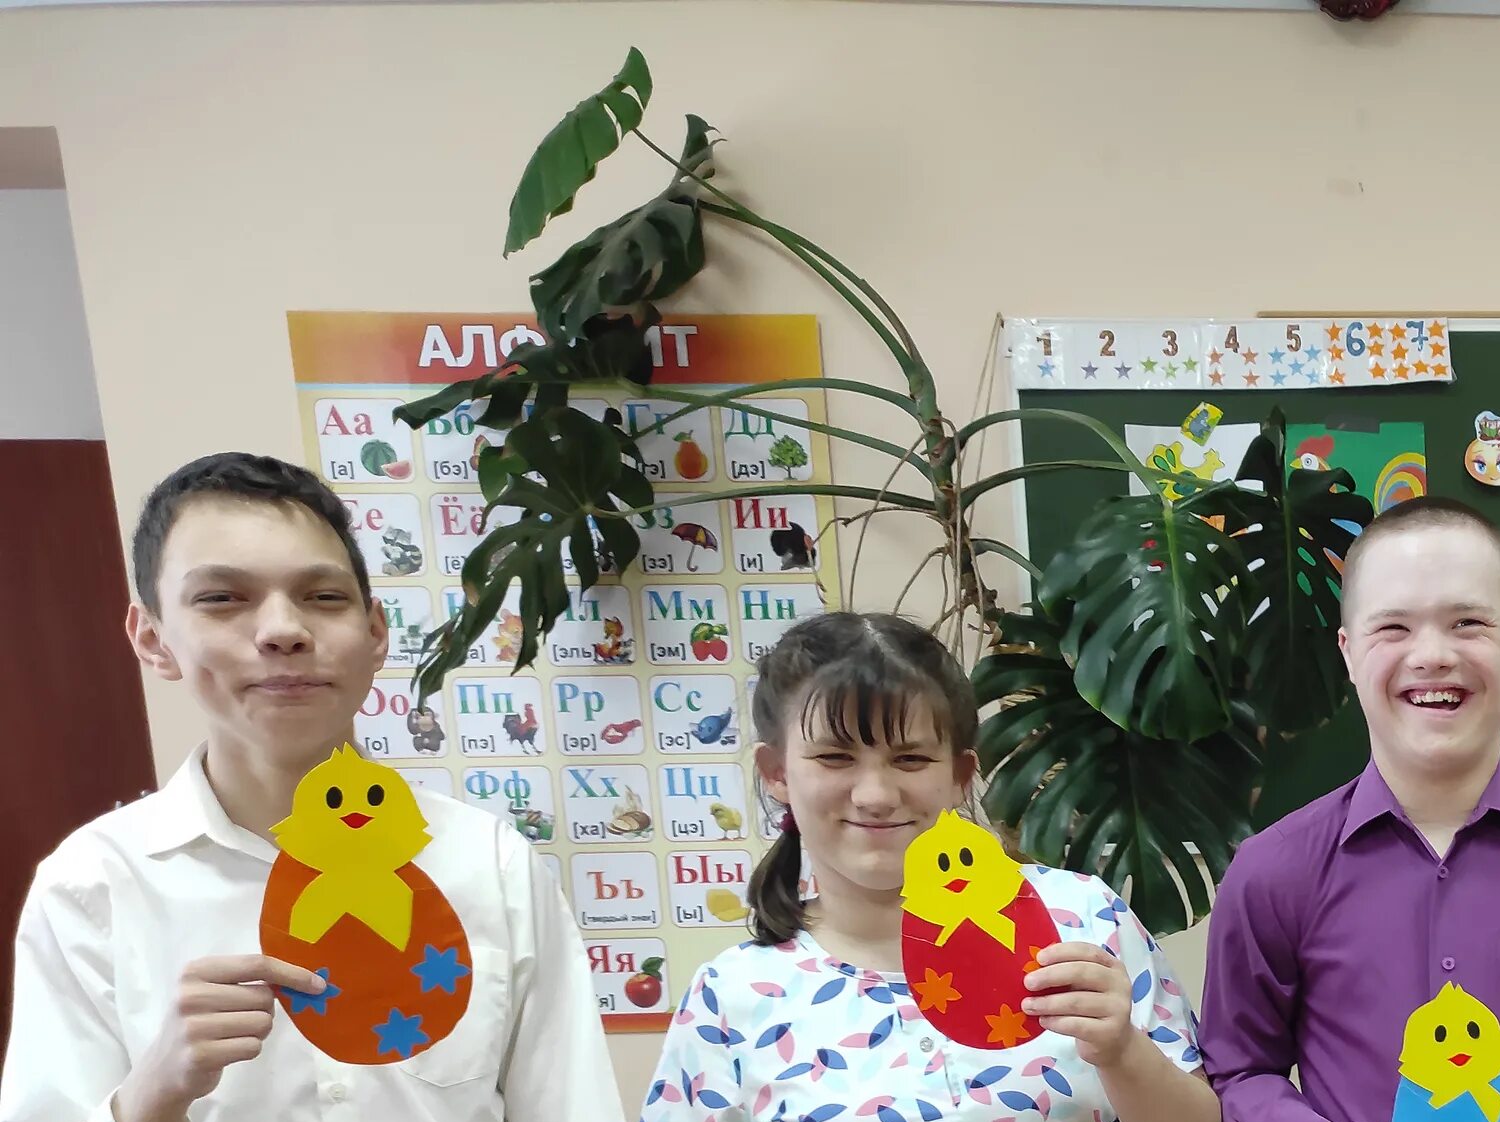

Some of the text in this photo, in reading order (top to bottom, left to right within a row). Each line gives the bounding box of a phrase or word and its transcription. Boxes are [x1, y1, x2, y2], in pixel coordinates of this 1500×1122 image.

[418, 324, 698, 367] АЛФТ
[1036, 320, 1429, 357] 1 2 3 4 5 6 7
[320, 404, 375, 436] Аа
[733, 498, 790, 530] Ии
[648, 589, 715, 622] Мм
[741, 589, 796, 621] Нн
[457, 683, 515, 715] Пп
[554, 682, 605, 722] Рр
[653, 681, 704, 713] Сс
[465, 769, 532, 809] Фф
[567, 768, 622, 799] Хх
[664, 767, 722, 803] Цц
[586, 870, 645, 901] Ъъ
[672, 854, 747, 885] Ыы
